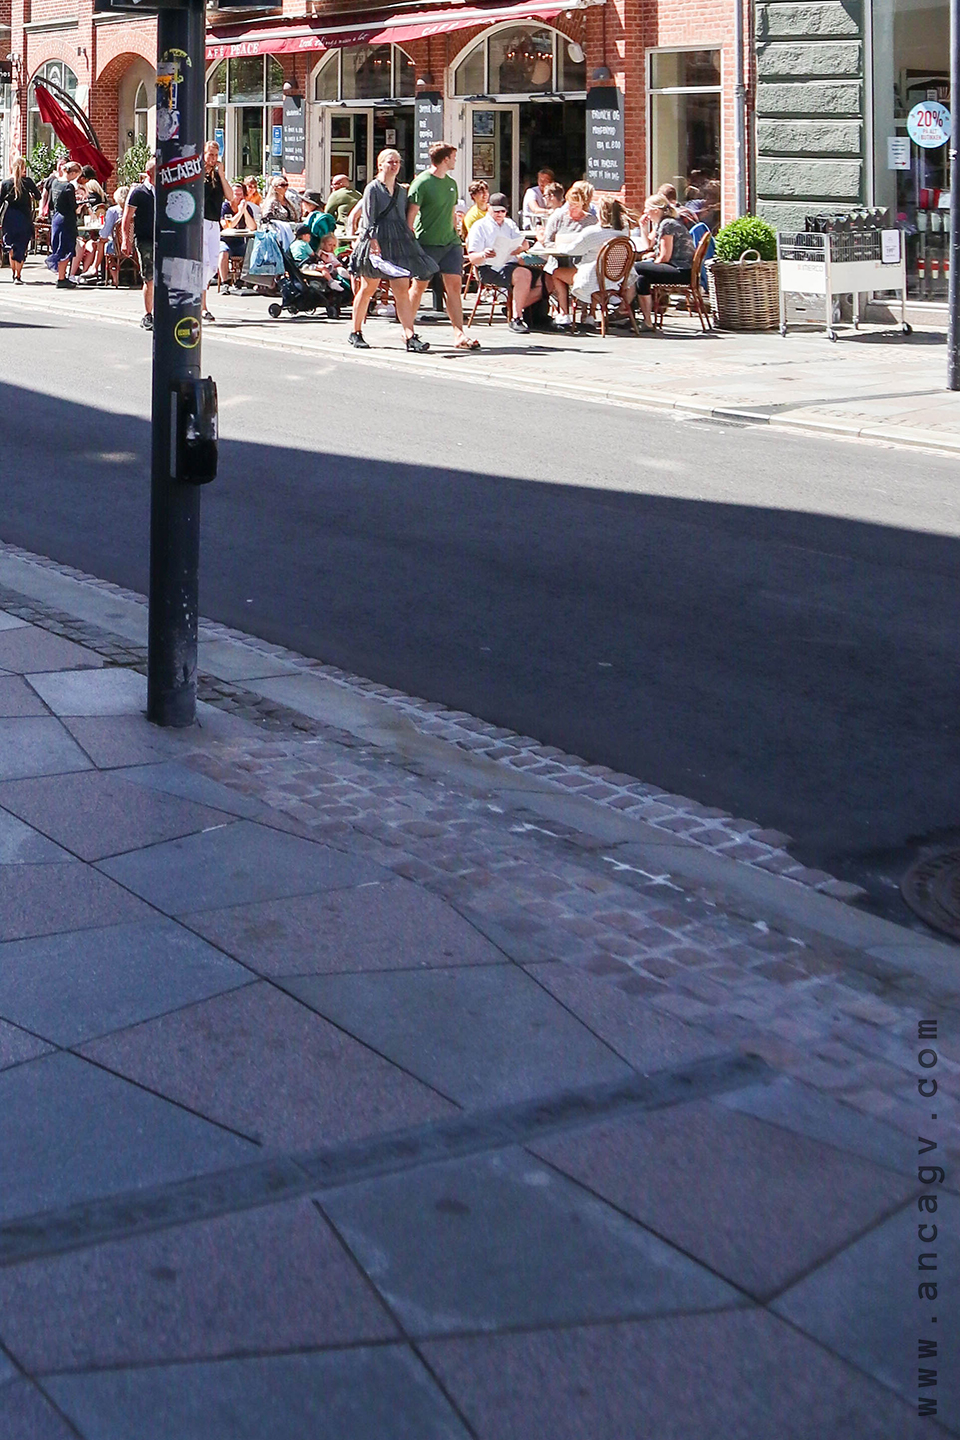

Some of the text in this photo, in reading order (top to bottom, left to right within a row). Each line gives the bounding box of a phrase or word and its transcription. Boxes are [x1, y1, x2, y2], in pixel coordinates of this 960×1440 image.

[206, 42, 260, 58] AFÉ PEACE
[917, 111, 943, 127] 20%
